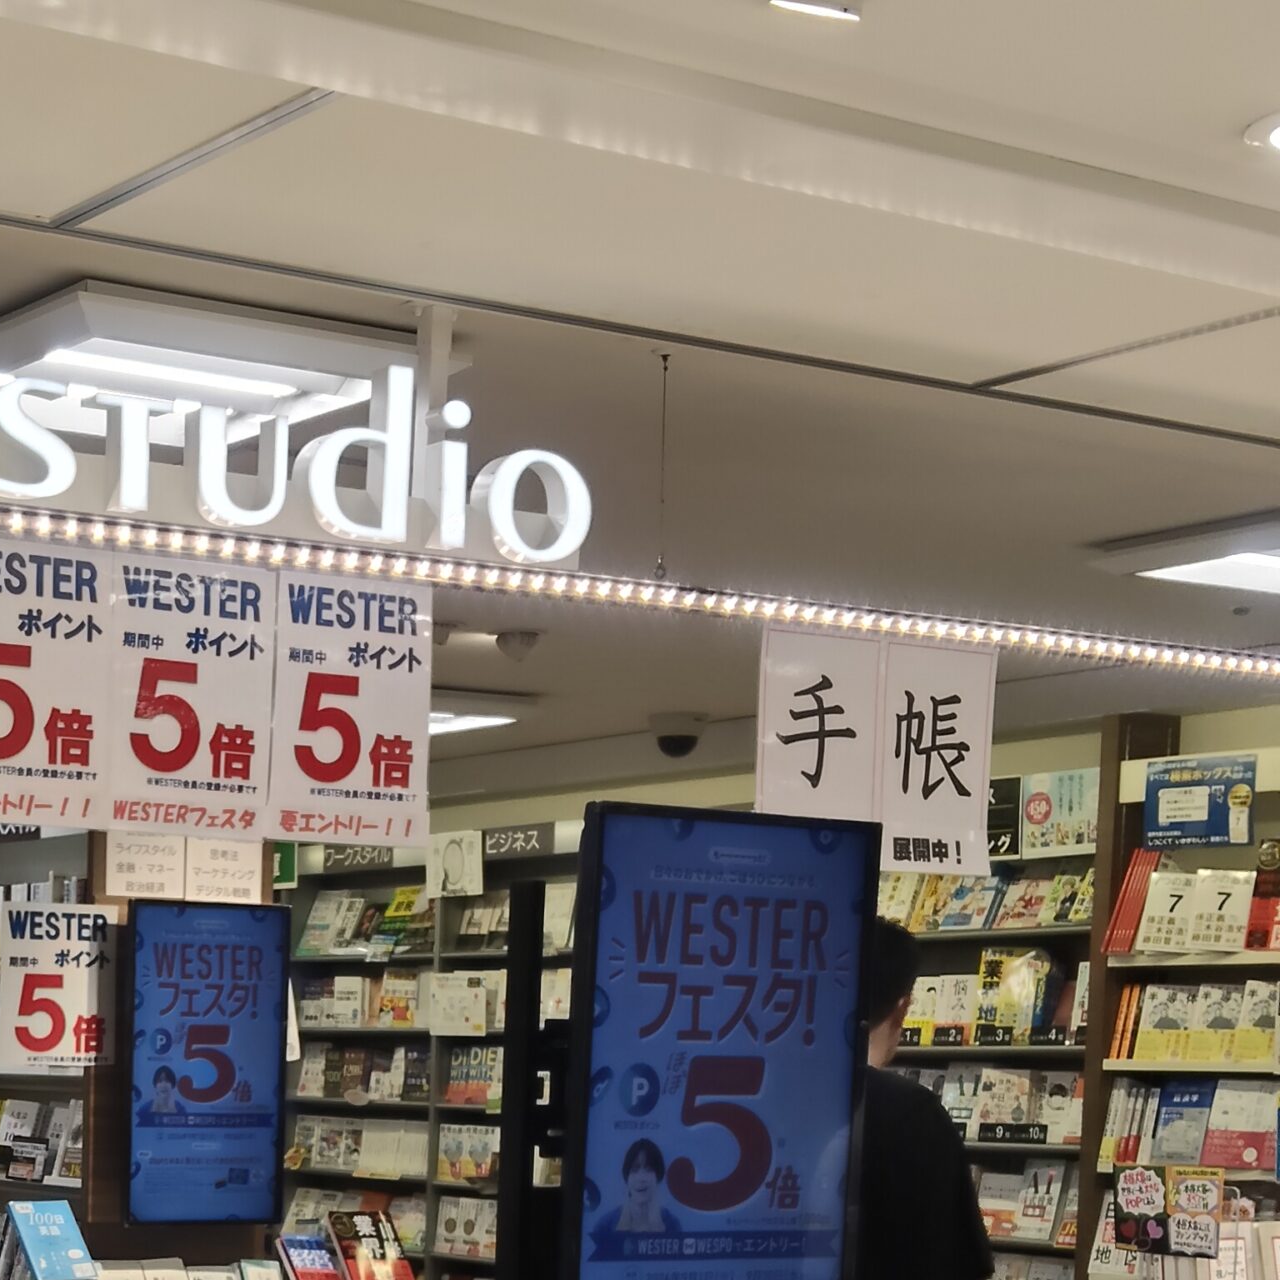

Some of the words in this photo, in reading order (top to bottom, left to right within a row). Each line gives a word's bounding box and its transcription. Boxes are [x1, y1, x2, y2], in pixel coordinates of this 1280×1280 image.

[122, 564, 262, 623] WESTER
[17, 608, 103, 643] ポイント
[288, 583, 418, 637] WESTER
[122, 632, 165, 651] 期間中
[185, 628, 265, 661] ポイント
[288, 647, 327, 665] 期間中
[348, 642, 422, 673] ポイント
[113, 800, 255, 831] WESTERフェスタ
[325, 847, 390, 867] ワークスタイル
[486, 830, 539, 853] ビジネス
[1169, 894, 1184, 913] 7
[1217, 892, 1232, 911] 7
[8, 910, 108, 942] WESTER
[632, 890, 830, 972] WESTER
[9, 956, 39, 968] 期間中
[54, 949, 110, 969] ポイント
[153, 942, 263, 982] WESTER
